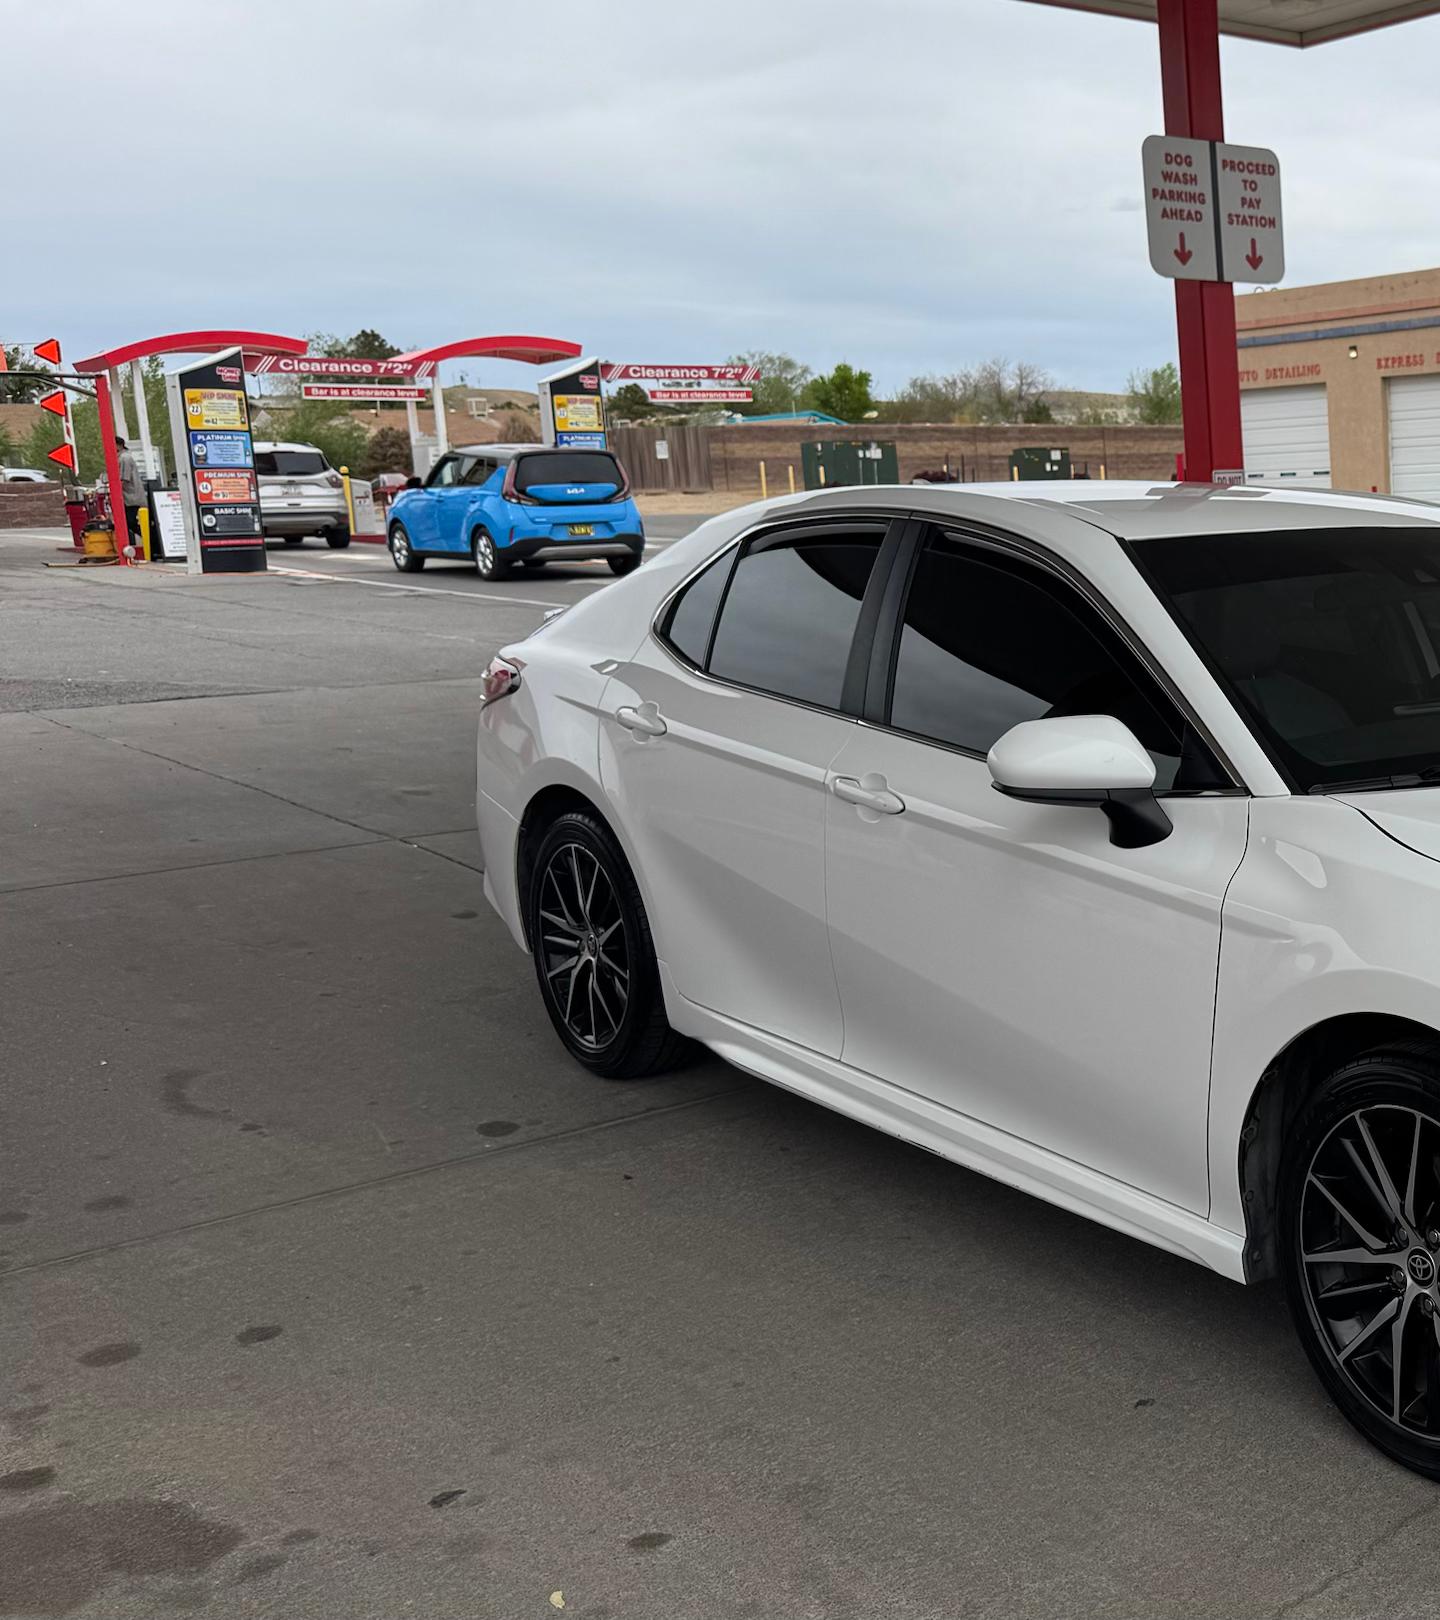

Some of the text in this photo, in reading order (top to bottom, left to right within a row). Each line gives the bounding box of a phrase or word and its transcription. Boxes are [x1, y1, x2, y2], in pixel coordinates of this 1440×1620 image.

[1164, 152, 1193, 167] DOG
[1221, 159, 1276, 177] PROCEED
[1161, 170, 1198, 186] WASH
[1241, 179, 1258, 192] TO
[1151, 187, 1206, 205] PARKING
[1240, 196, 1262, 210] PAY
[1161, 207, 1203, 223] AHEAD
[1227, 213, 1276, 229] STATION
[279, 358, 373, 374] Clearance
[1376, 353, 1425, 369] EXPRESS
[629, 366, 708, 379] Clearance
[1265, 363, 1321, 380] DETAILING
[311, 387, 328, 396] Bar
[330, 388, 340, 396] is
[352, 389, 395, 397] clearance
[397, 389, 418, 398] level
[656, 391, 746, 399] Bar is at clearance level
[214, 507, 235, 515] BASIC
